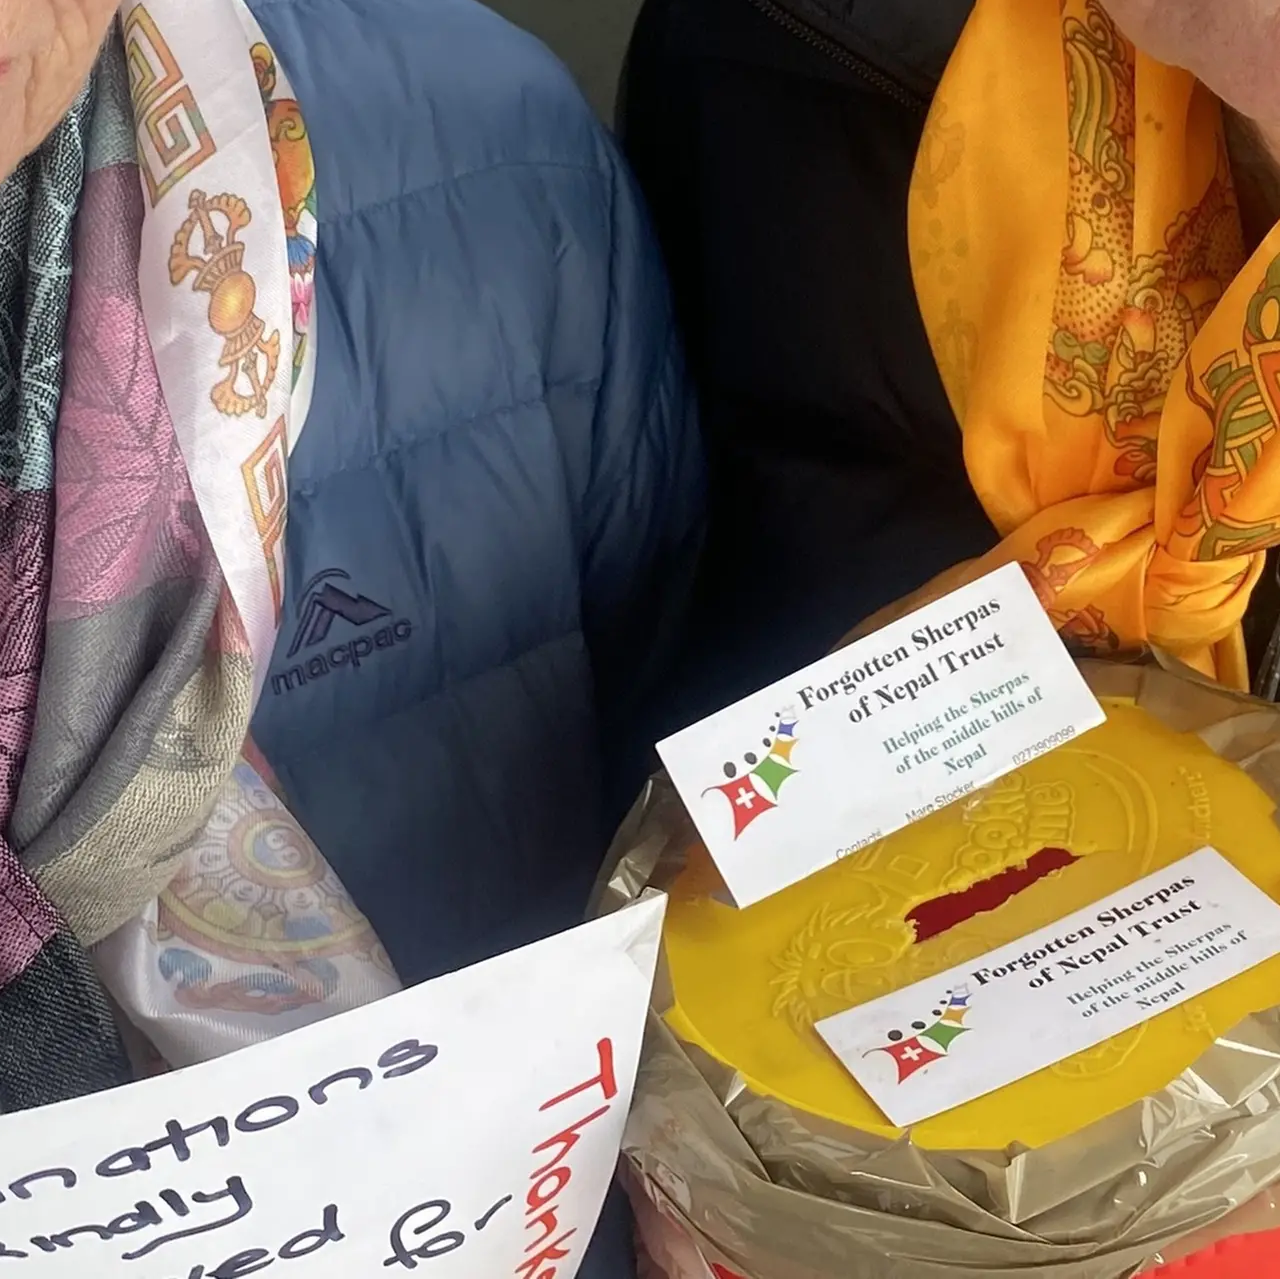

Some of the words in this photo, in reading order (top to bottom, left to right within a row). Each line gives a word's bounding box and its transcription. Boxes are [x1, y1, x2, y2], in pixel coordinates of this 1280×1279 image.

[270, 617, 413, 696] macpac
[796, 645, 910, 711] Forgotten
[910, 597, 1001, 651] Sherpas
[848, 694, 871, 724] of
[872, 663, 939, 711] Nepal
[937, 631, 1005, 675] Trust
[882, 718, 945, 754] Helping
[944, 704, 970, 724] the
[969, 670, 1031, 709] Sherpas
[895, 757, 912, 775] of
[914, 744, 939, 765] the
[941, 717, 992, 752] middle
[990, 700, 1026, 724] hills
[1027, 686, 1044, 705] of
[933, 780, 976, 809] Stocker
[942, 743, 988, 776] Nepal
[970, 924, 1096, 987] Forgotten
[1096, 874, 1196, 928] Sherpas
[1028, 966, 1057, 989] of
[1057, 932, 1130, 976] Nepal
[1127, 897, 1202, 938] Trust
[1066, 969, 1136, 1006] Helping
[1135, 955, 1165, 974] the
[1163, 923, 1232, 959] Sherpas
[1081, 1002, 1099, 1019] of
[1102, 990, 1131, 1009] the
[1133, 960, 1190, 994] middle
[1189, 943, 1228, 965] hills
[1229, 928, 1248, 946] of
[1135, 980, 1187, 1011] Nepal
